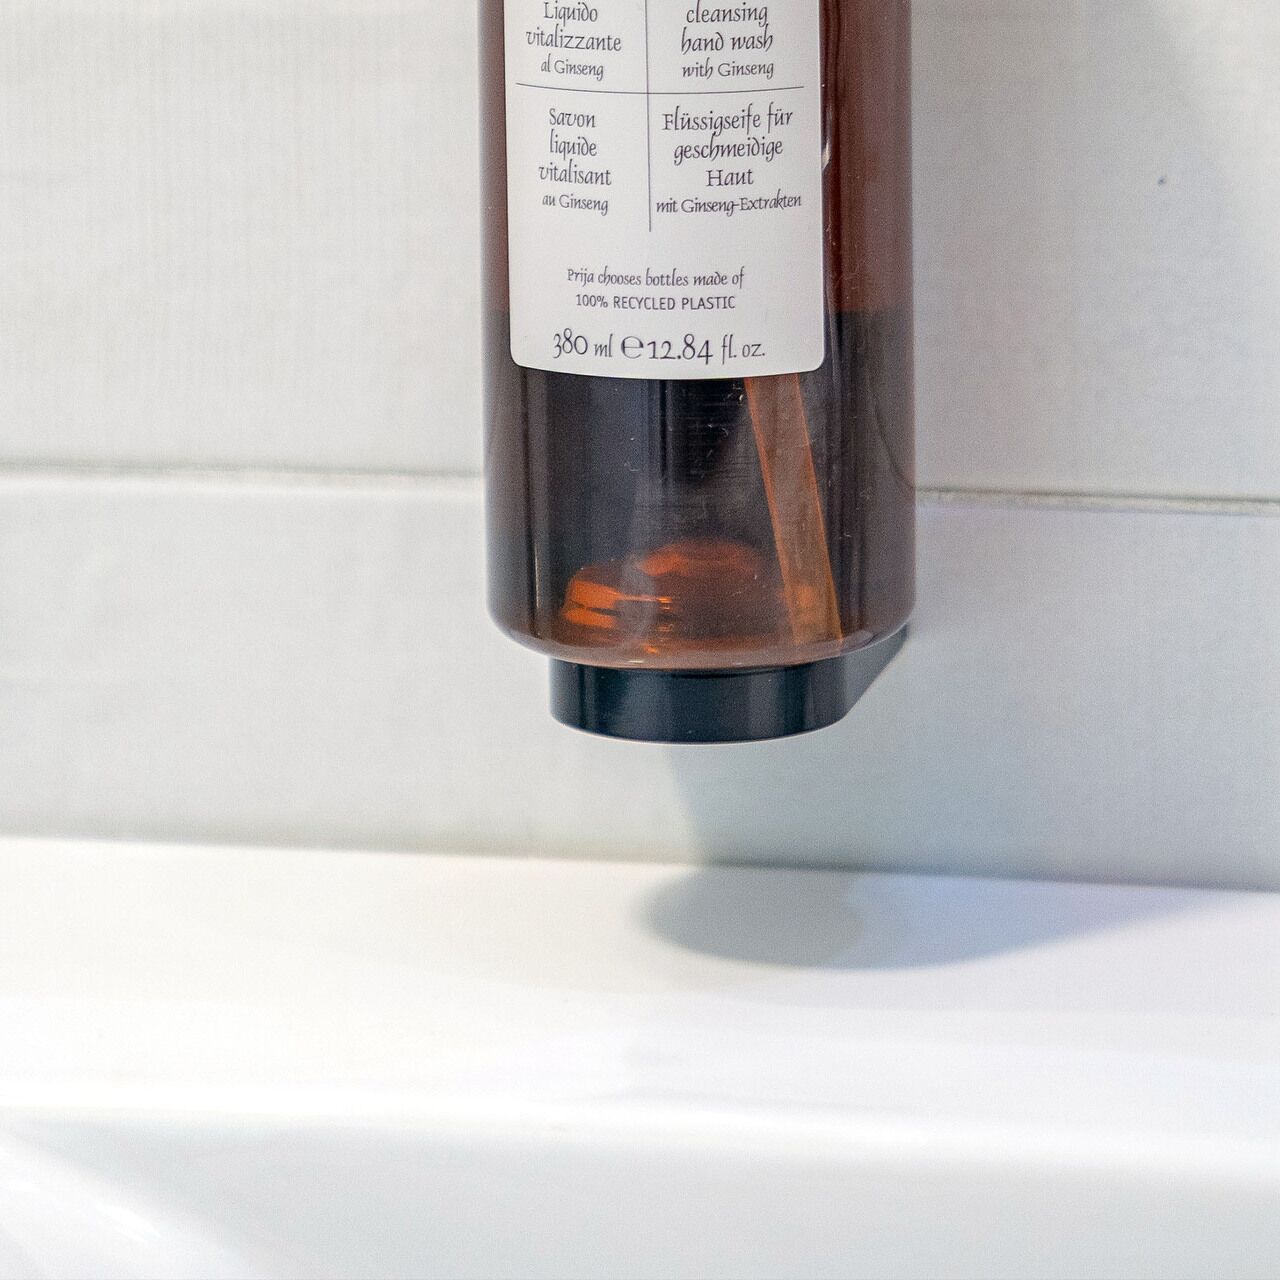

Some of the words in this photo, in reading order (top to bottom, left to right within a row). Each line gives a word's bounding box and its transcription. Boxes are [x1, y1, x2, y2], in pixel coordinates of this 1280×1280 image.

[543, 0, 598, 27] Liquido
[526, 23, 622, 52] vitalizzante
[681, 26, 724, 55] hand
[731, 23, 774, 52] wash
[540, 53, 551, 73] al
[554, 59, 604, 81] Ginseng
[682, 57, 713, 79] with
[718, 61, 774, 80] Ginseng
[549, 108, 597, 128] Savon
[661, 103, 761, 137] Flüssigseife
[767, 101, 794, 134] für
[549, 128, 598, 160] liquide
[673, 131, 784, 166] geschmeidige
[538, 158, 612, 186] vitalisant
[706, 169, 755, 187] Haut
[542, 194, 556, 206] au
[559, 193, 609, 216] Ginseng
[656, 197, 678, 213] mit
[681, 188, 802, 217] Ginseng-Extrakten
[567, 268, 594, 287] Prija
[597, 265, 642, 287] chooses
[645, 267, 689, 287] bottles
[693, 271, 728, 286] made
[731, 265, 745, 289] of
[575, 294, 609, 308] 100%
[613, 296, 676, 310] RECYCLED
[681, 296, 736, 310] PLASTIC
[553, 327, 589, 359] 380
[594, 333, 614, 358] ml
[721, 333, 737, 365] fl.
[741, 343, 766, 358] oz.
